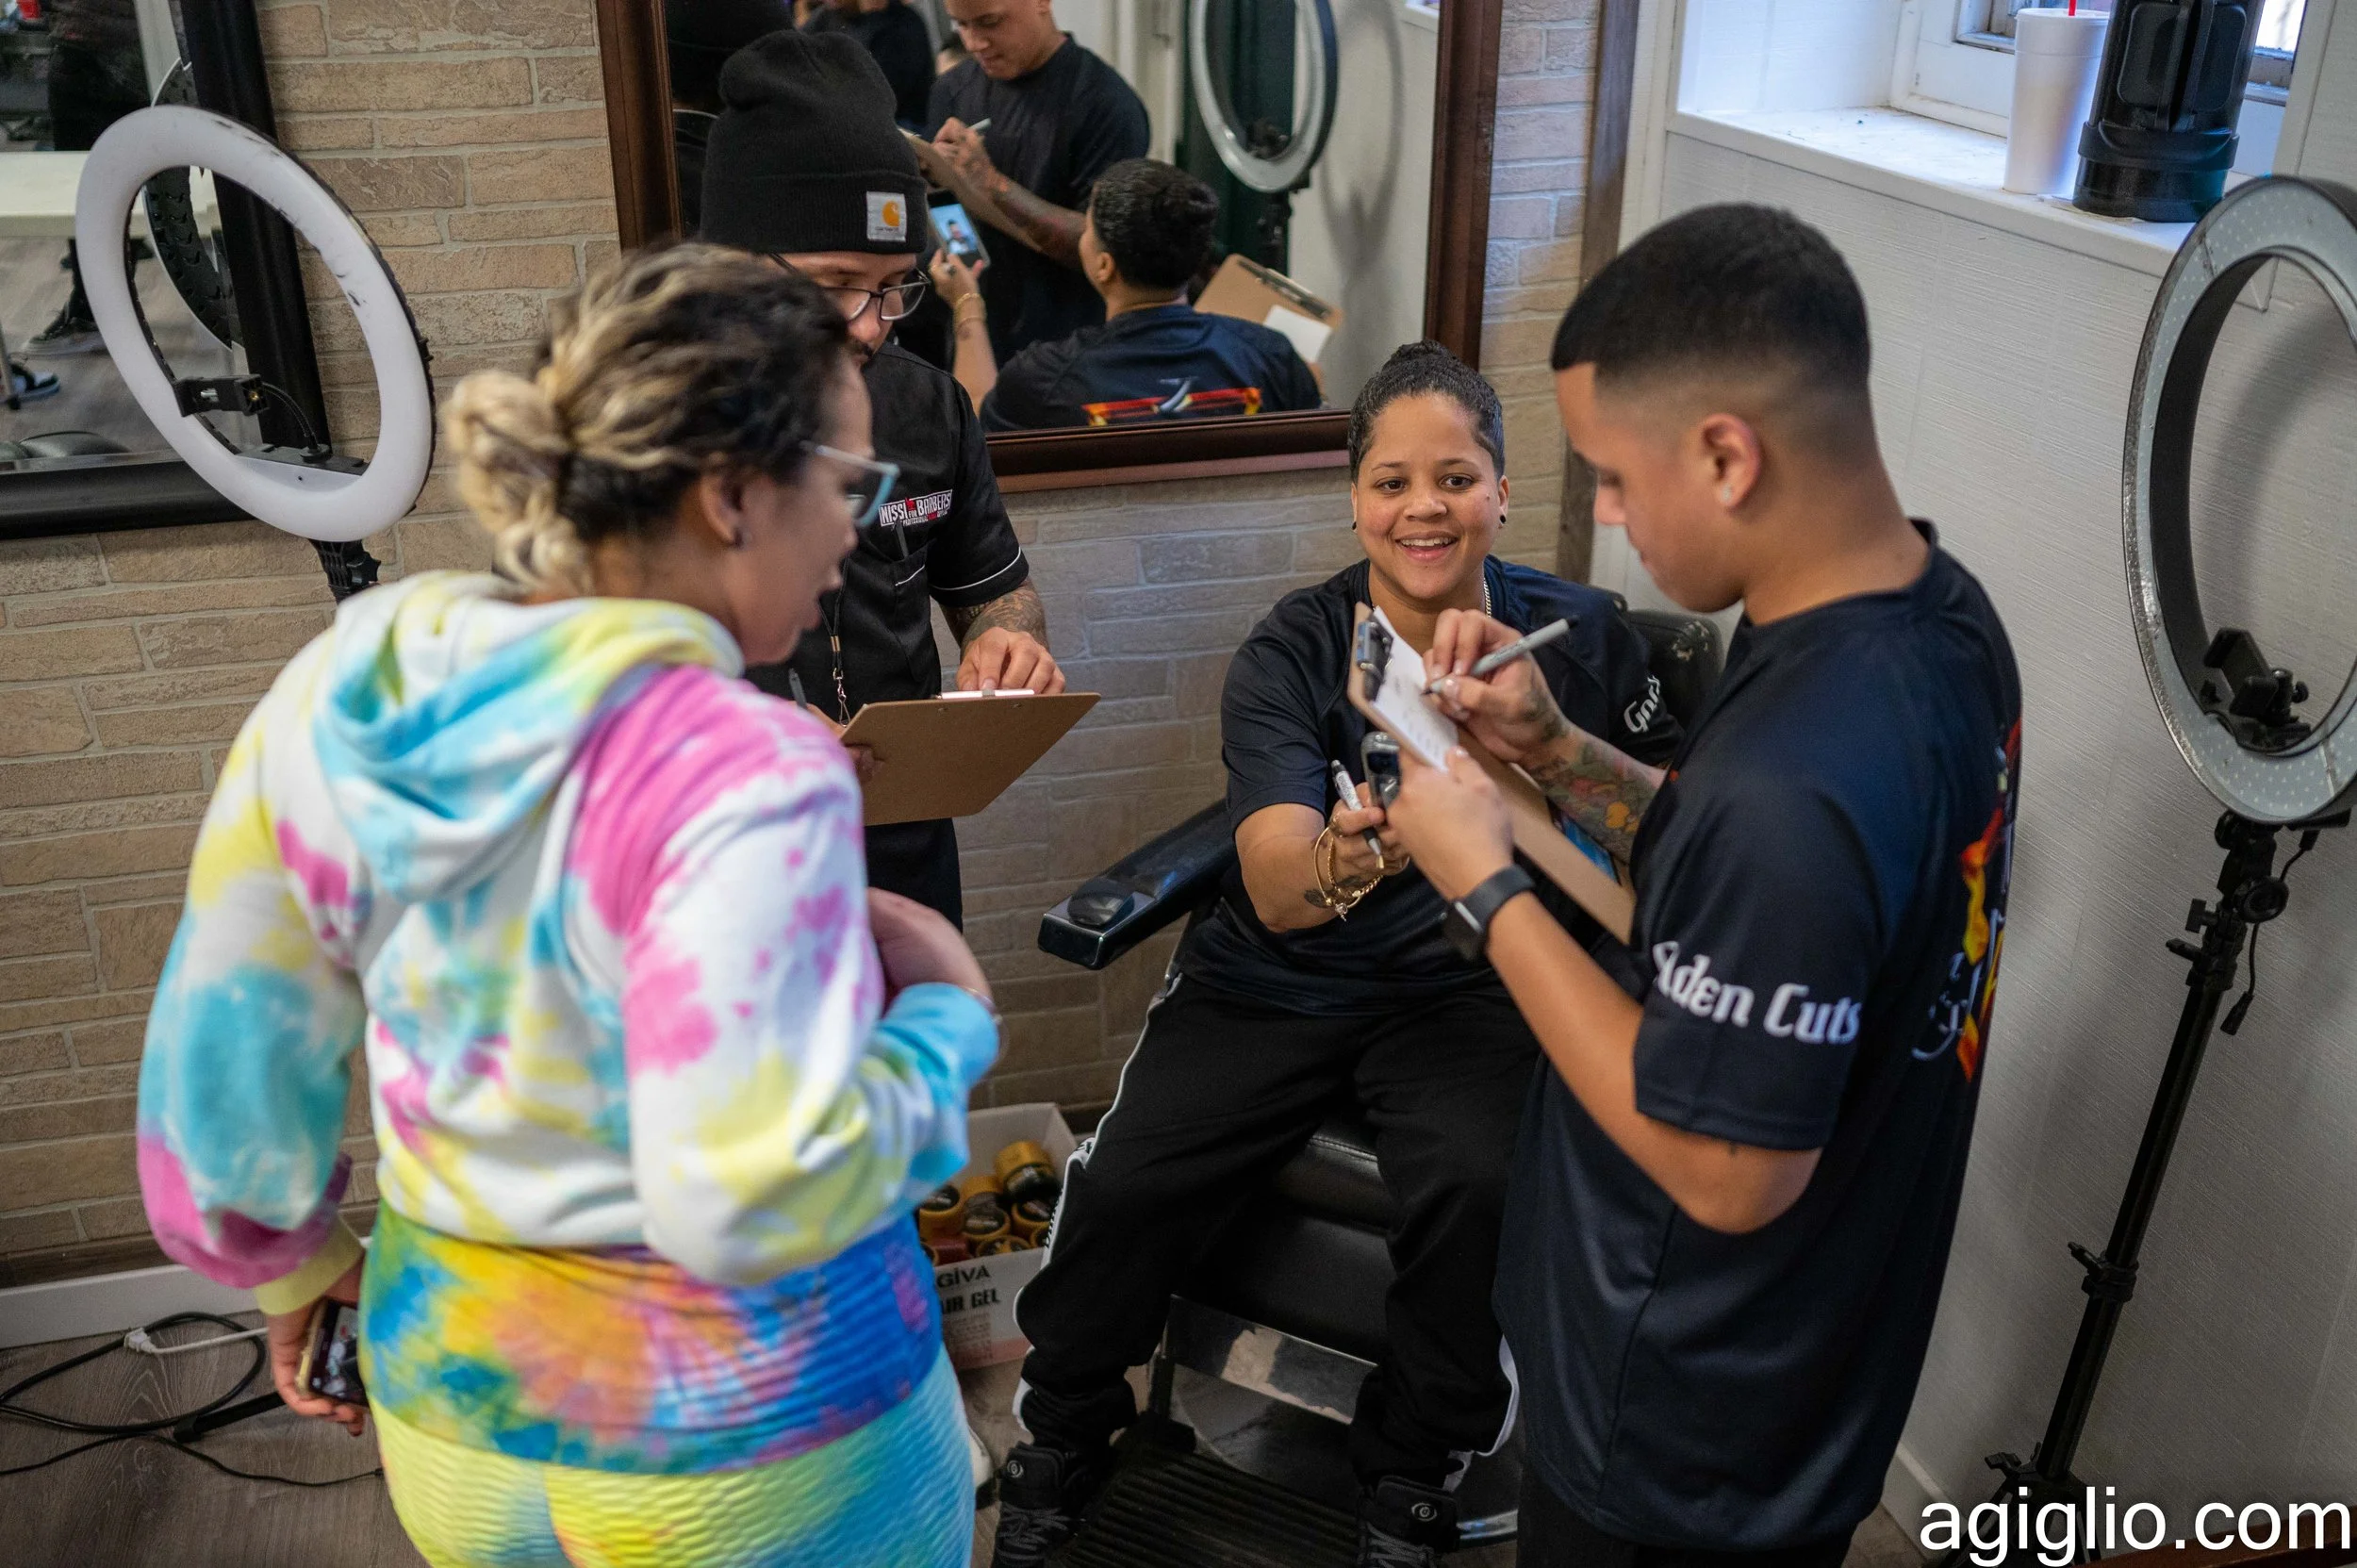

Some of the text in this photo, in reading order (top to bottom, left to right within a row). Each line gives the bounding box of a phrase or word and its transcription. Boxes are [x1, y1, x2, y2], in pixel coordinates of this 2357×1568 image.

[880, 502, 909, 524] NISSI
[915, 493, 951, 517] BARBERS
[1763, 982, 1863, 1045] Cuts
[971, 1288, 1000, 1310] GEL
